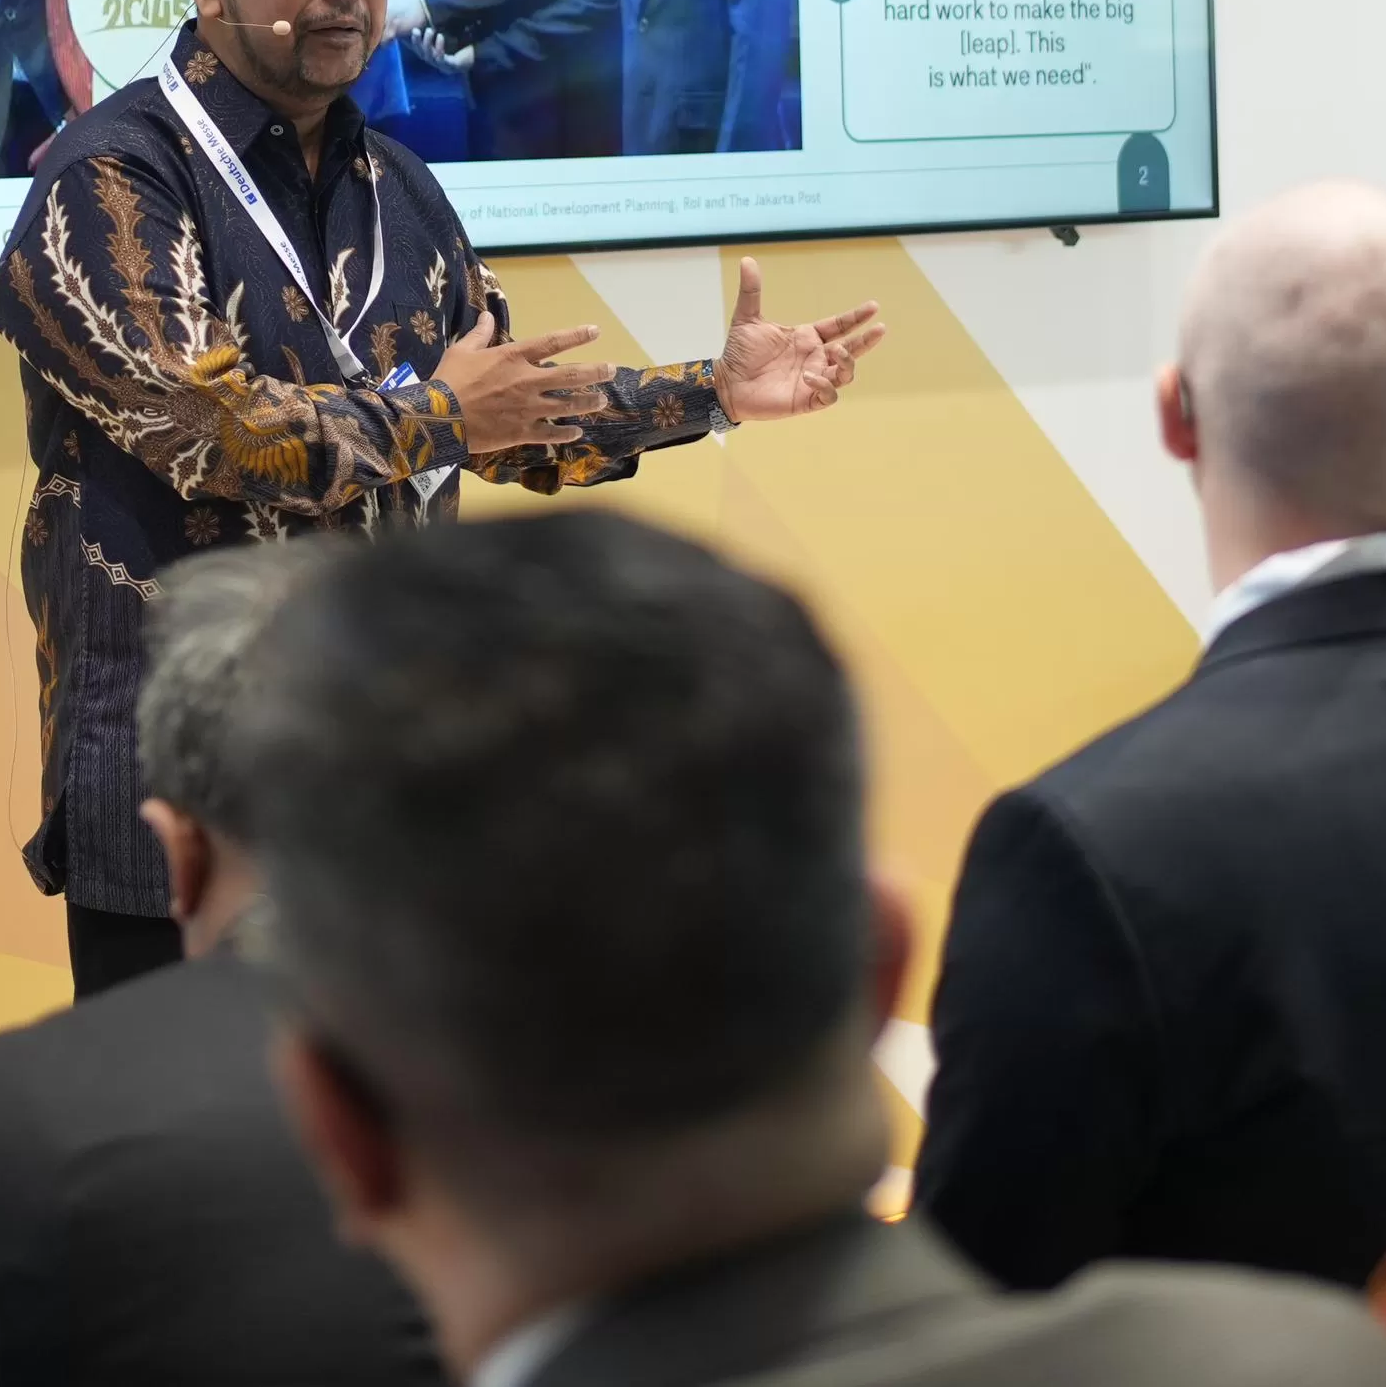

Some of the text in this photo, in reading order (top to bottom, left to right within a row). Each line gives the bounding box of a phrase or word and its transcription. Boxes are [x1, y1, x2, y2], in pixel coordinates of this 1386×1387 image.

[988, 0, 1009, 20] to
[960, 30, 1066, 59] [leap]. This
[928, 66, 945, 88] is
[950, 65, 998, 88] what
[1002, 68, 1031, 88] we
[196, 117, 251, 195] Deutsche Messe
[1138, 166, 1150, 187] 2
[470, 206, 483, 219] of
[486, 201, 539, 218] National
[542, 200, 622, 217] Development
[704, 195, 726, 209] and
[729, 193, 751, 209] The
[754, 192, 795, 207] Jakarta
[798, 191, 822, 206] Post
